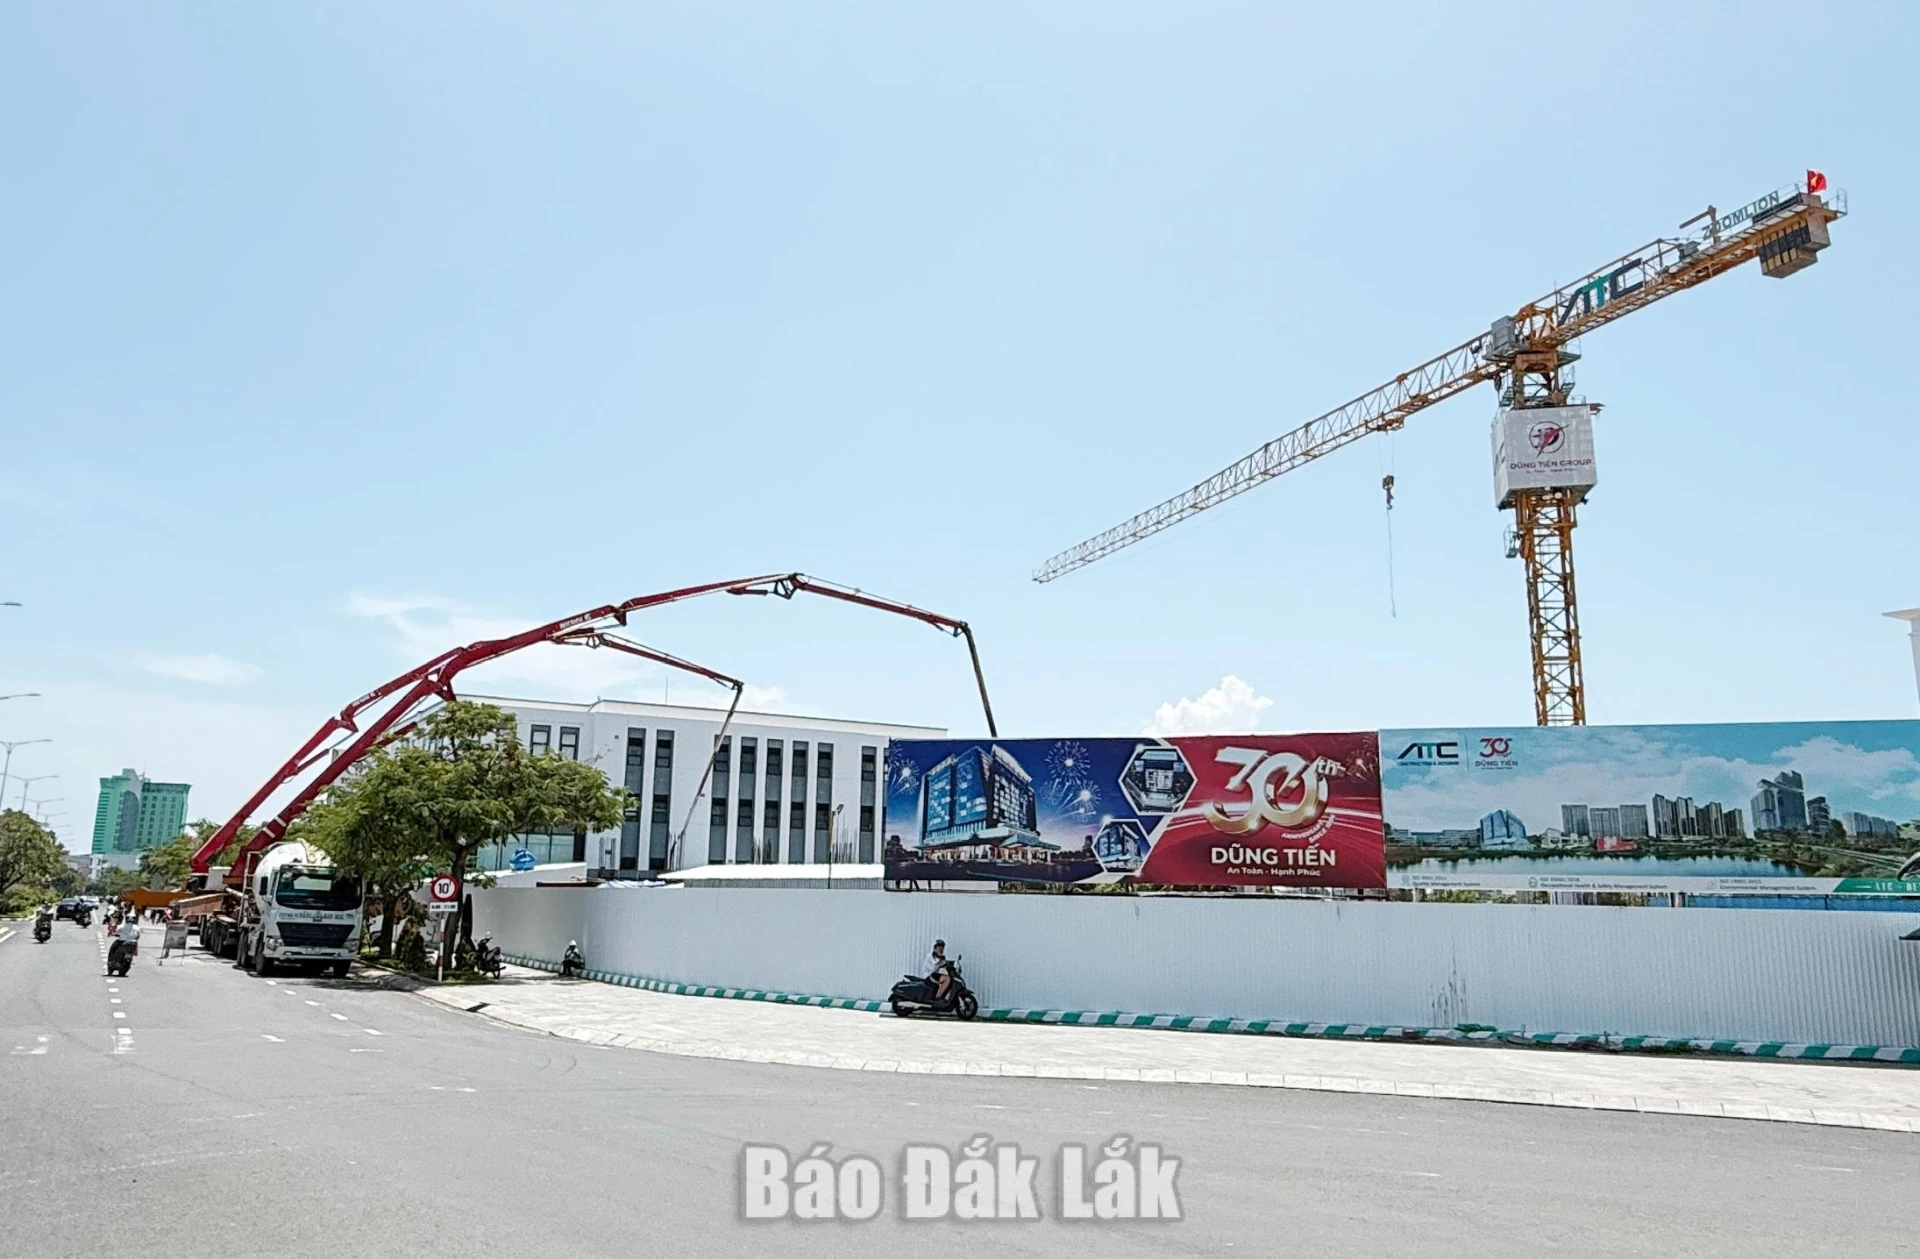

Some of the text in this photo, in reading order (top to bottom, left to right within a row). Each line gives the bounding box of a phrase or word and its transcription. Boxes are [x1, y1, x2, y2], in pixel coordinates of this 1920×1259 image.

[1702, 190, 1779, 241] ZOOMLION
[1557, 257, 1643, 327] ATC
[1560, 459, 1592, 467] GROUP
[1397, 742, 1459, 759] ATC
[1211, 843, 1336, 867] DŨNG TIẾN
[1227, 866, 1240, 875] An
[1241, 866, 1264, 876] Toàn
[1270, 867, 1295, 877] Hạnh
[1297, 867, 1321, 877] Phúc
